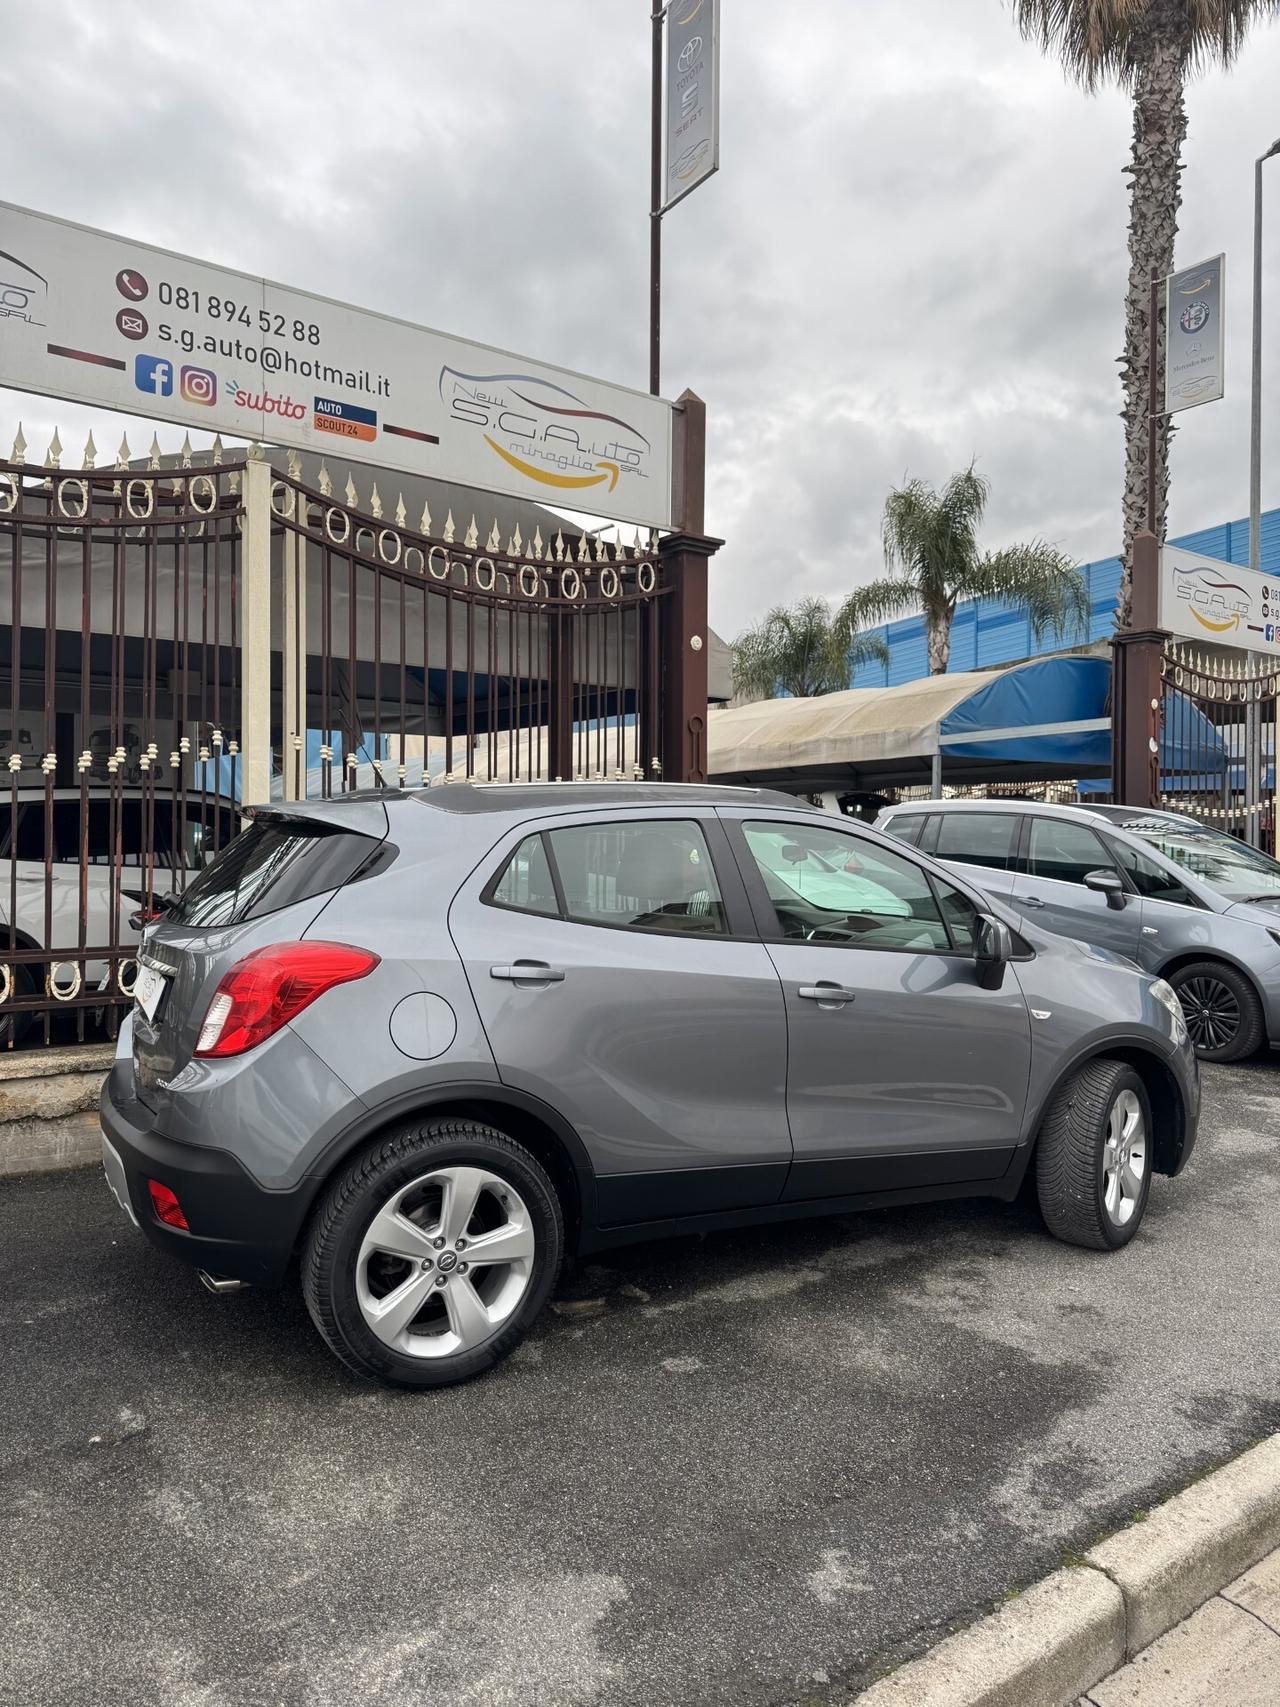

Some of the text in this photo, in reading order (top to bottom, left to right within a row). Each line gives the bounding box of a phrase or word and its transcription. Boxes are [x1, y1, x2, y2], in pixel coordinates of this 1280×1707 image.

[676, 61, 704, 93] TOYOTA
[158, 282, 320, 346] 081 894 52 88
[158, 324, 391, 398] s.g.auto@hotmail.it
[234, 390, 307, 420] subito
[317, 401, 342, 416] AUTO
[453, 381, 508, 409] New
